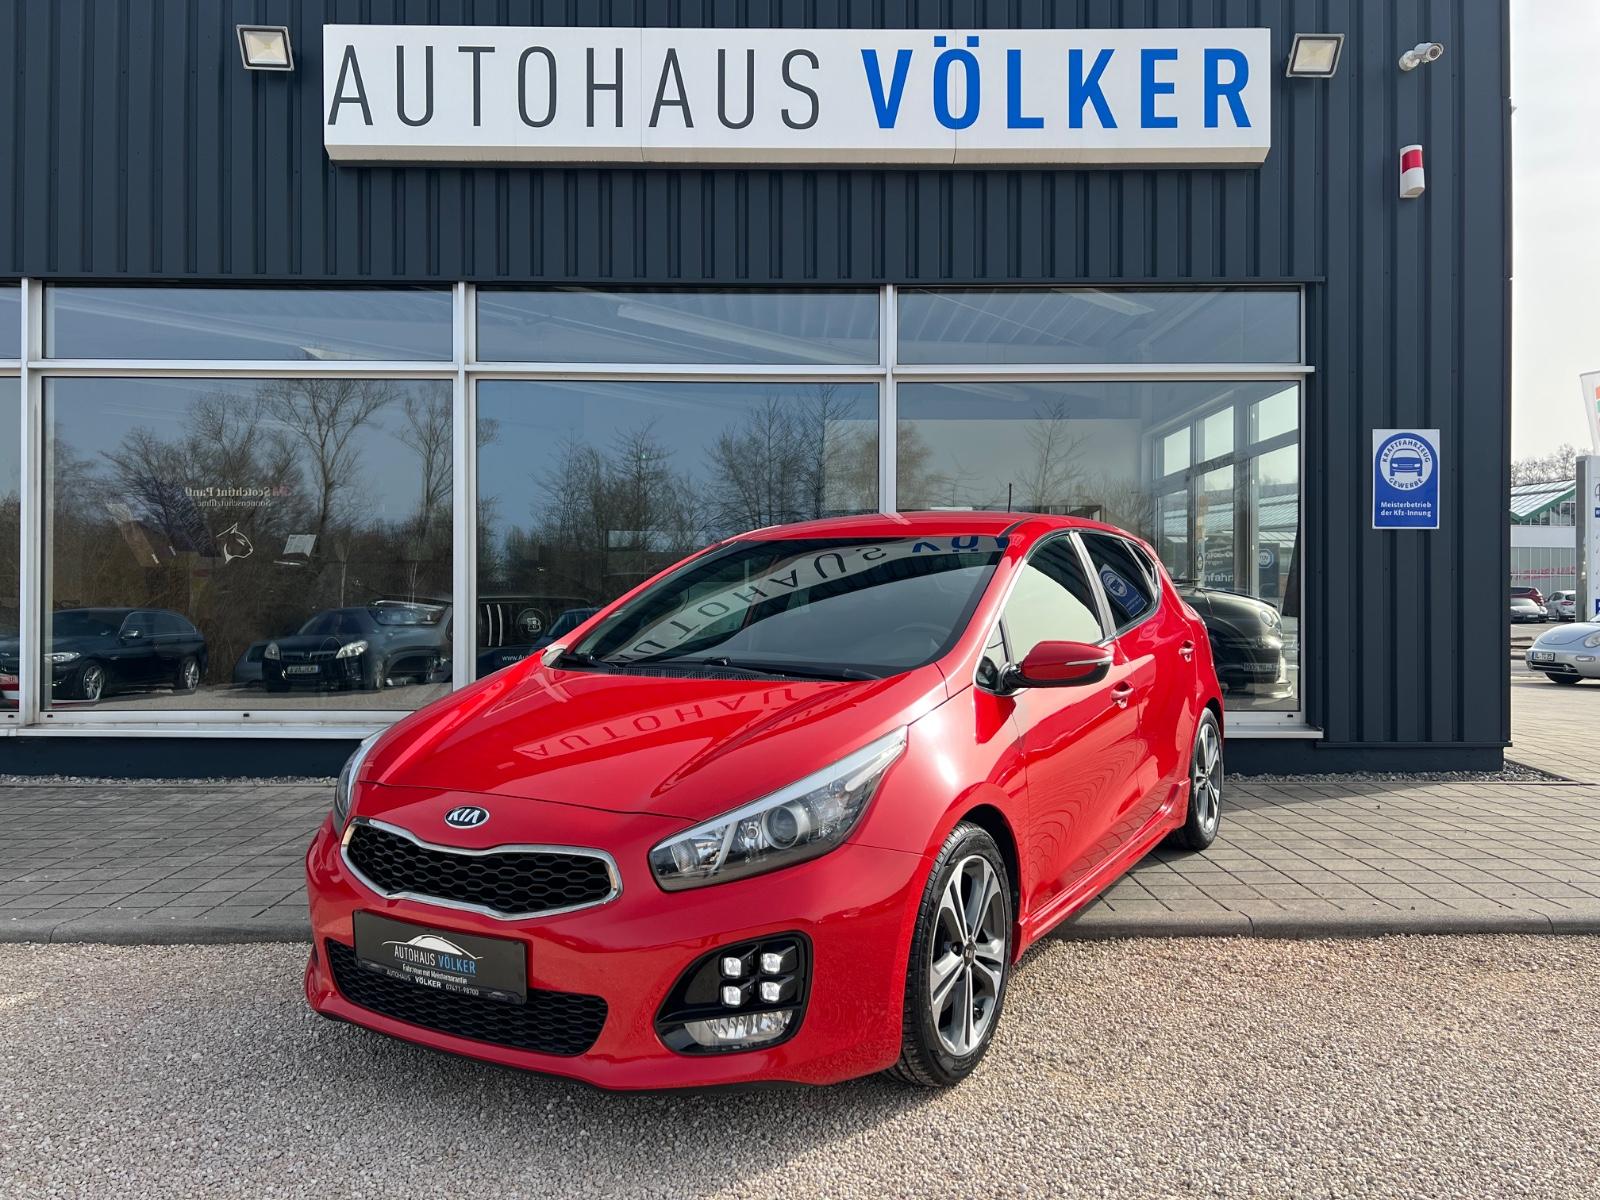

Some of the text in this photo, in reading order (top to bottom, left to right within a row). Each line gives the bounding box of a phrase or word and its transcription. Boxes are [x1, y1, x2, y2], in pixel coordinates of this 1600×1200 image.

[328, 36, 1252, 129] AUTOHAUS VÖLKER
[1382, 439, 1431, 463] KRAFTFAHRZEUG
[1388, 477, 1424, 489] GEWERBE
[448, 808, 481, 824] KIA
[394, 944, 476, 974] AUTOHAUS VÖLKER
[386, 969, 411, 982] AUTOHAUS
[414, 975, 442, 989] VÖLKER
